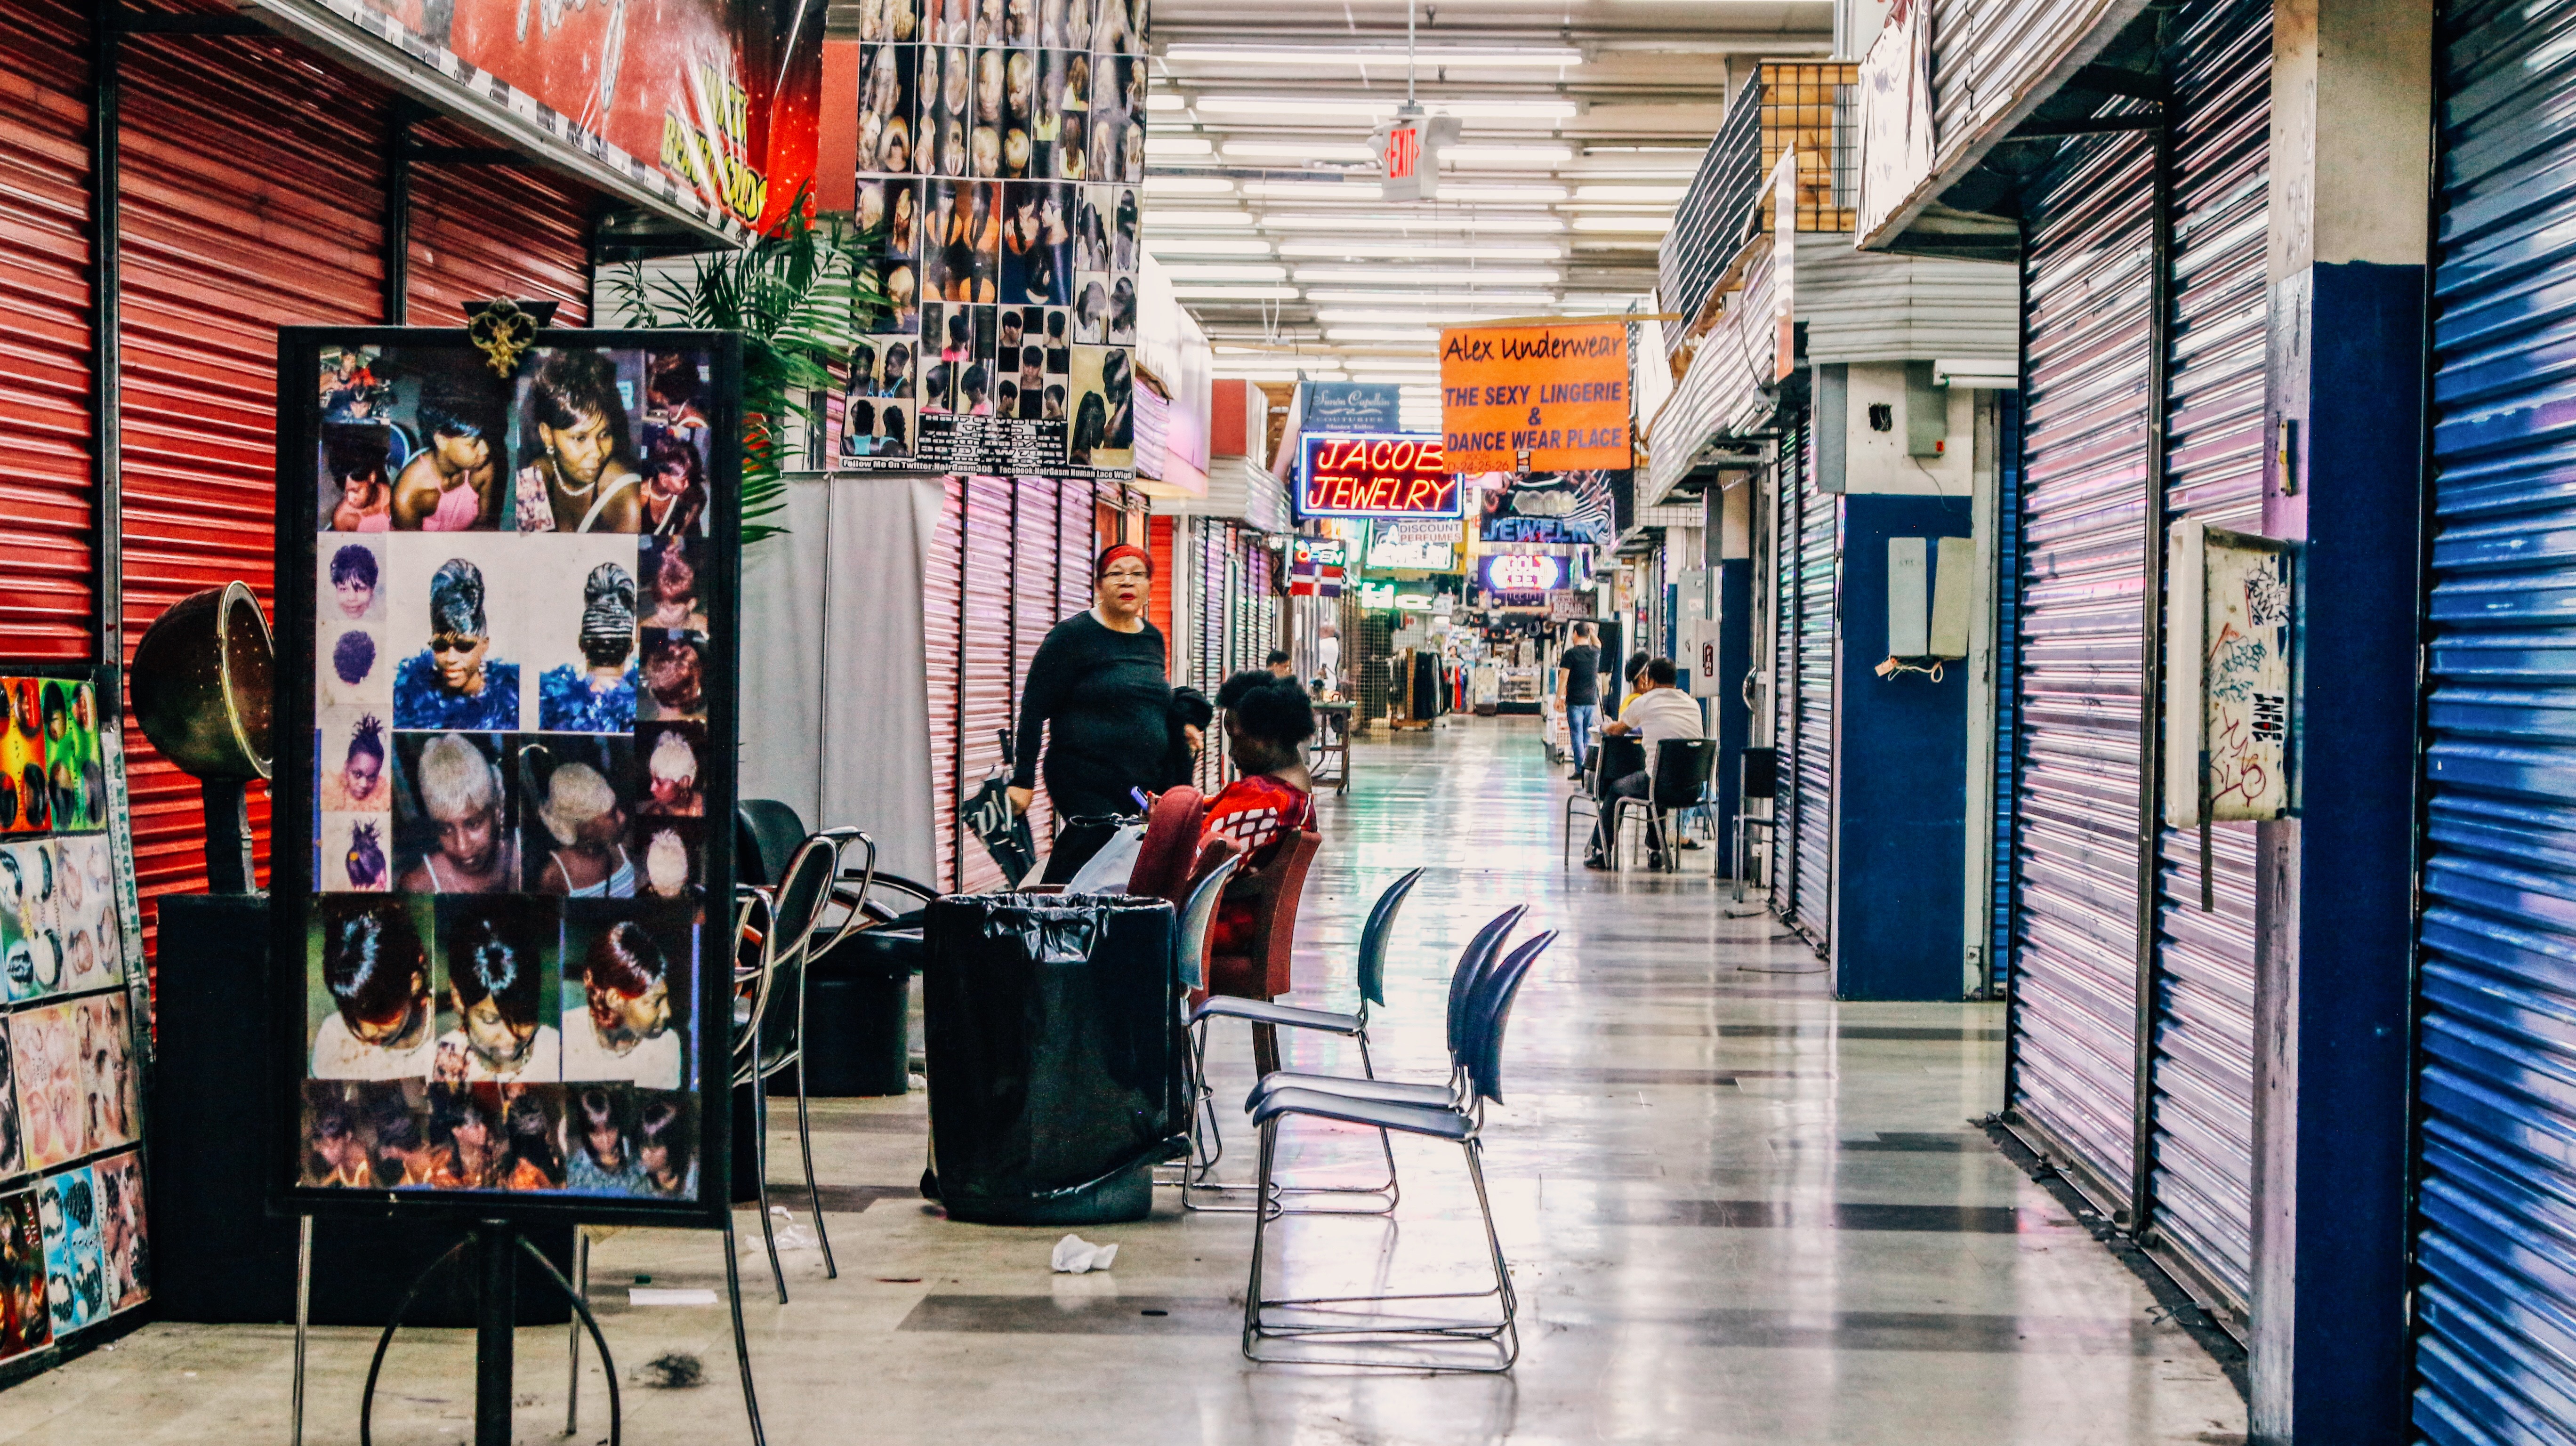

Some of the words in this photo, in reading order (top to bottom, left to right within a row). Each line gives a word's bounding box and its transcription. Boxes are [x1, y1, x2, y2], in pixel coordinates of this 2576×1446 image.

[1390, 129, 1416, 178] EXIT
[1443, 334, 1494, 362] Alex
[1502, 330, 1623, 360] Underwear
[1445, 387, 1479, 407] THE
[1484, 385, 1530, 406] SEXY
[1540, 382, 1622, 403] LINGERIE
[1528, 406, 1542, 426] &
[1447, 432, 1506, 452] DANCE
[1511, 429, 1561, 449] WEAR
[1567, 427, 1622, 448] PLACE
[843, 459, 871, 467] Follow
[873, 460, 886, 468] Me
[888, 461, 900, 469] On
[1071, 468, 1095, 478] Human
[1096, 470, 1113, 479] Lace
[1114, 471, 1132, 480] Wigs
[1308, 476, 1456, 511] JEWELRY
[1400, 524, 1460, 533] DISCOUNT
[1400, 533, 1461, 541] PERFUMES
[1297, 550, 1344, 564] OPEN
[113, 752, 140, 935] WELCOME
